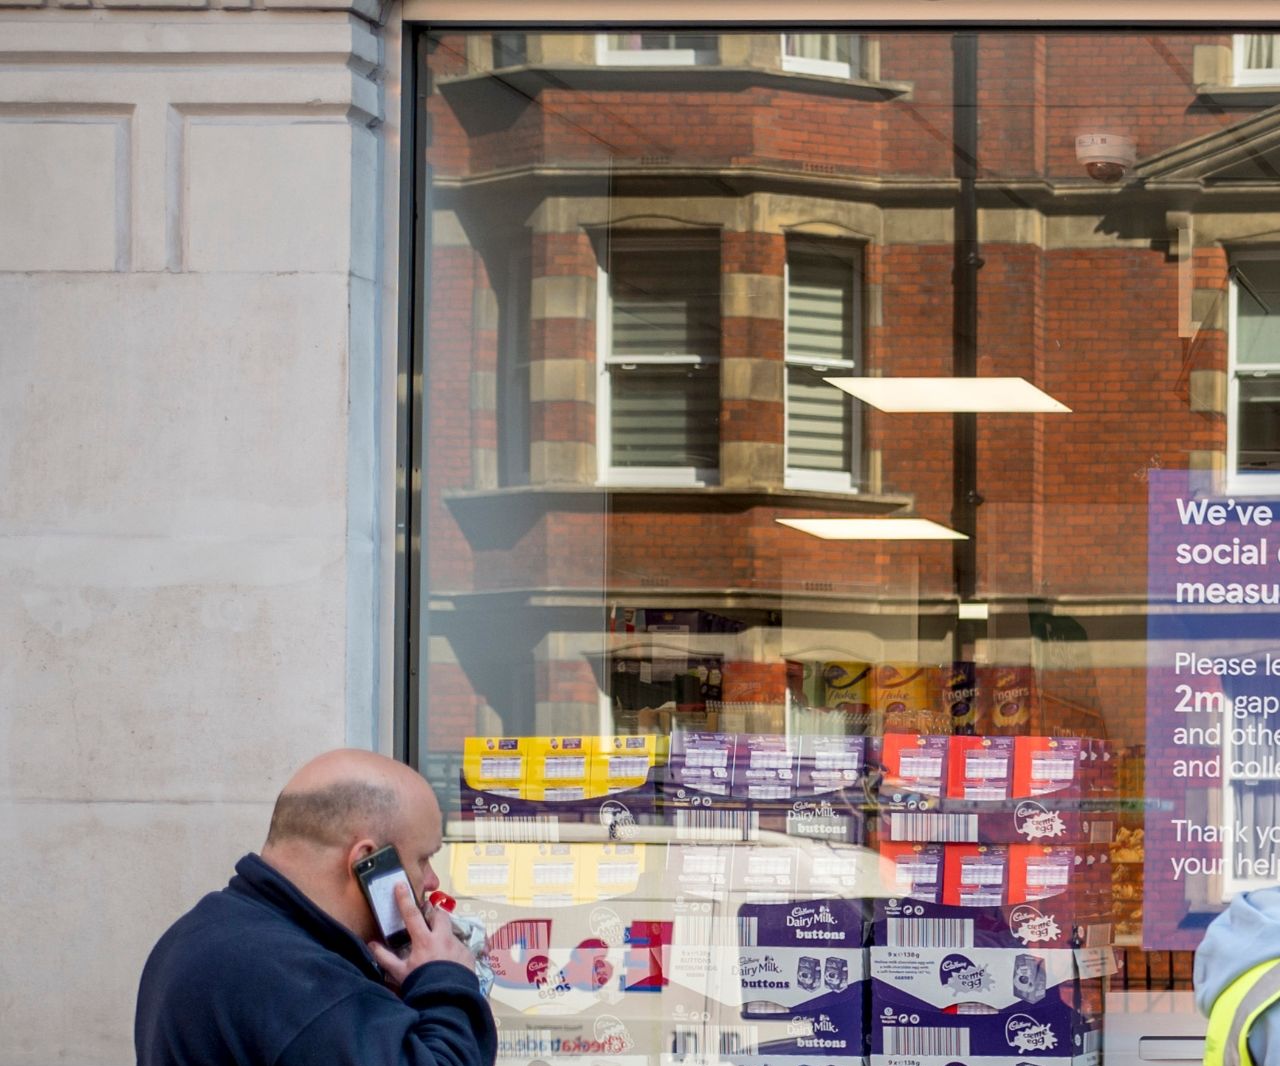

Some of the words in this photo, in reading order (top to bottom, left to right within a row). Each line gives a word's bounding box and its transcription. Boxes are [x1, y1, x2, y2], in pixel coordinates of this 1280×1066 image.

[1176, 498, 1272, 526] We've
[1176, 538, 1267, 565] social
[1175, 652, 1257, 676] Please
[1174, 685, 1223, 713] 2m
[1233, 695, 1279, 719] gap
[1173, 724, 1221, 745] and
[1173, 755, 1221, 778] and
[1171, 819, 1248, 843] Thank
[1170, 857, 1227, 880] your
